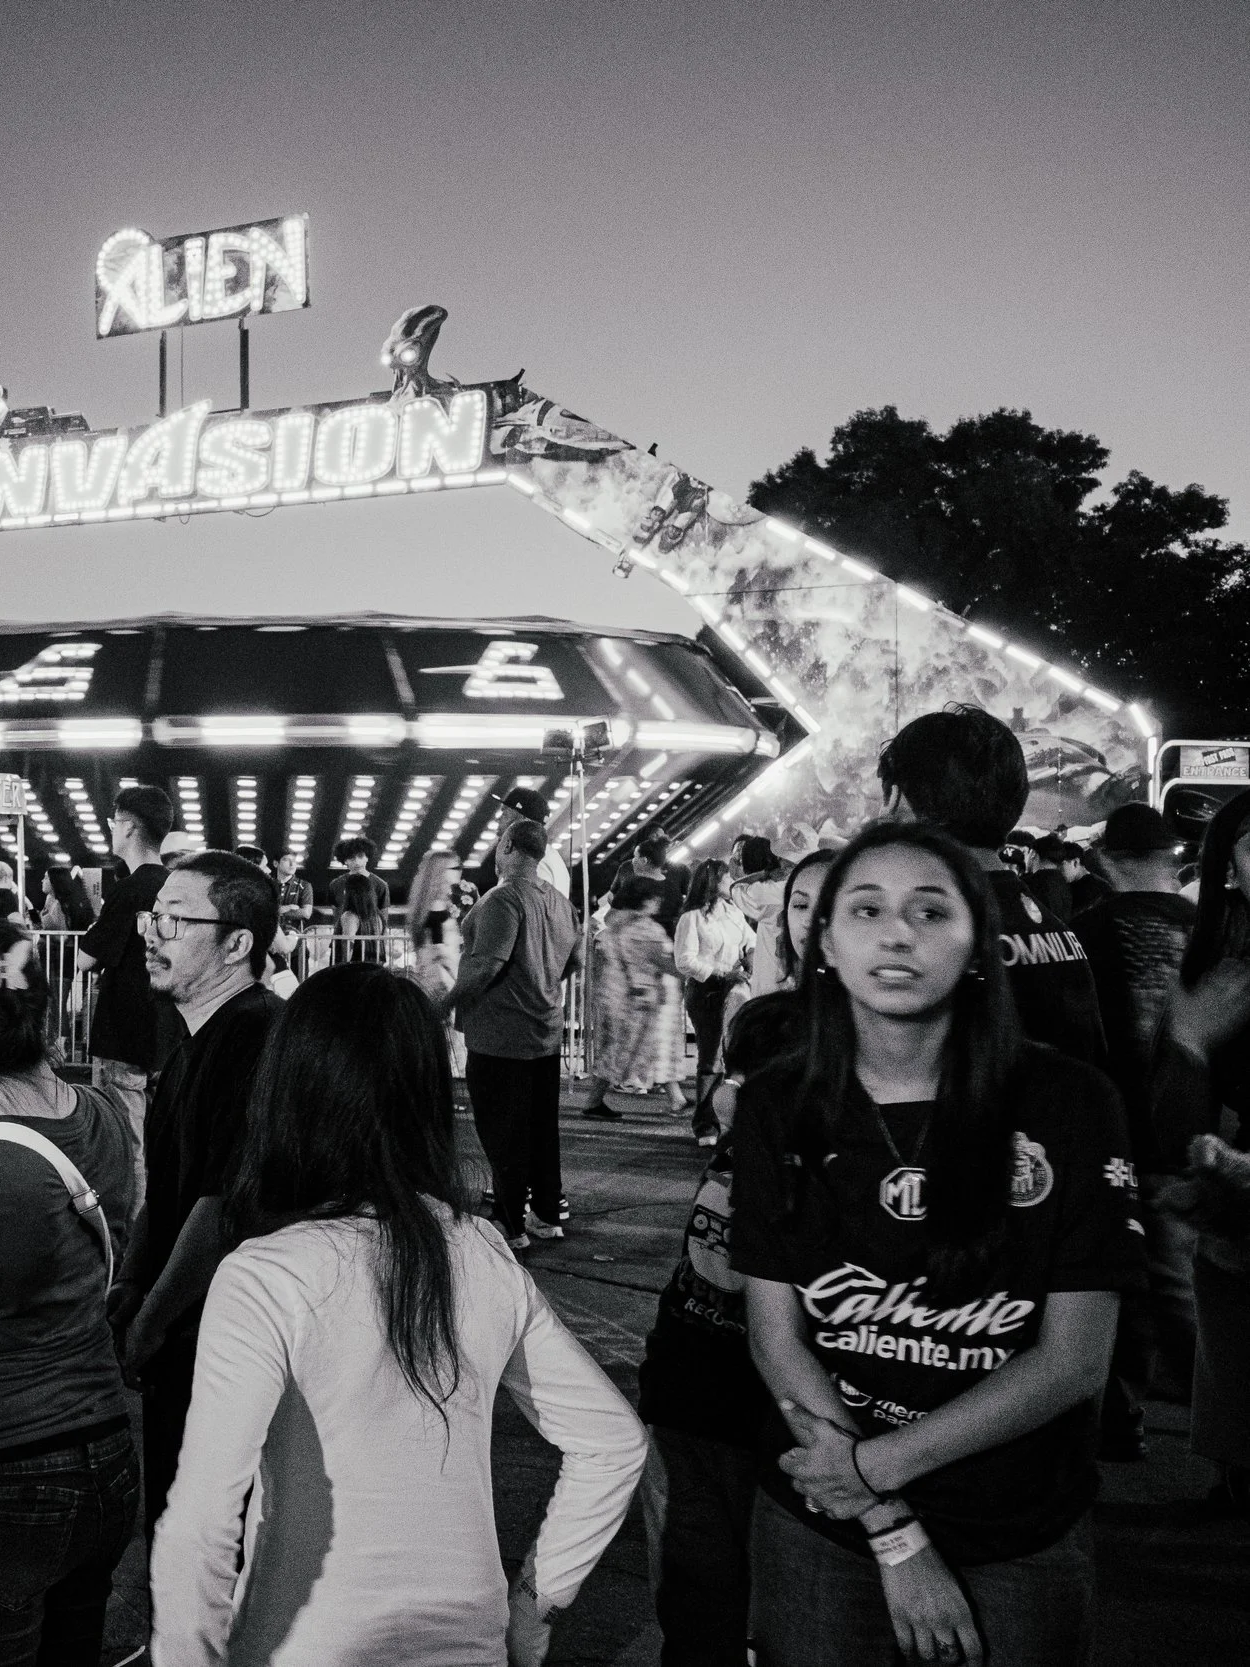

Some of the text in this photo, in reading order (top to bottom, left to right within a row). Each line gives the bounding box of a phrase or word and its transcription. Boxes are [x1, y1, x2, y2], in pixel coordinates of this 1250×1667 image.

[97, 215, 306, 335] ALIEN
[1183, 765, 1247, 777] ENTRANCE
[792, 1262, 1036, 1336] Caliente
